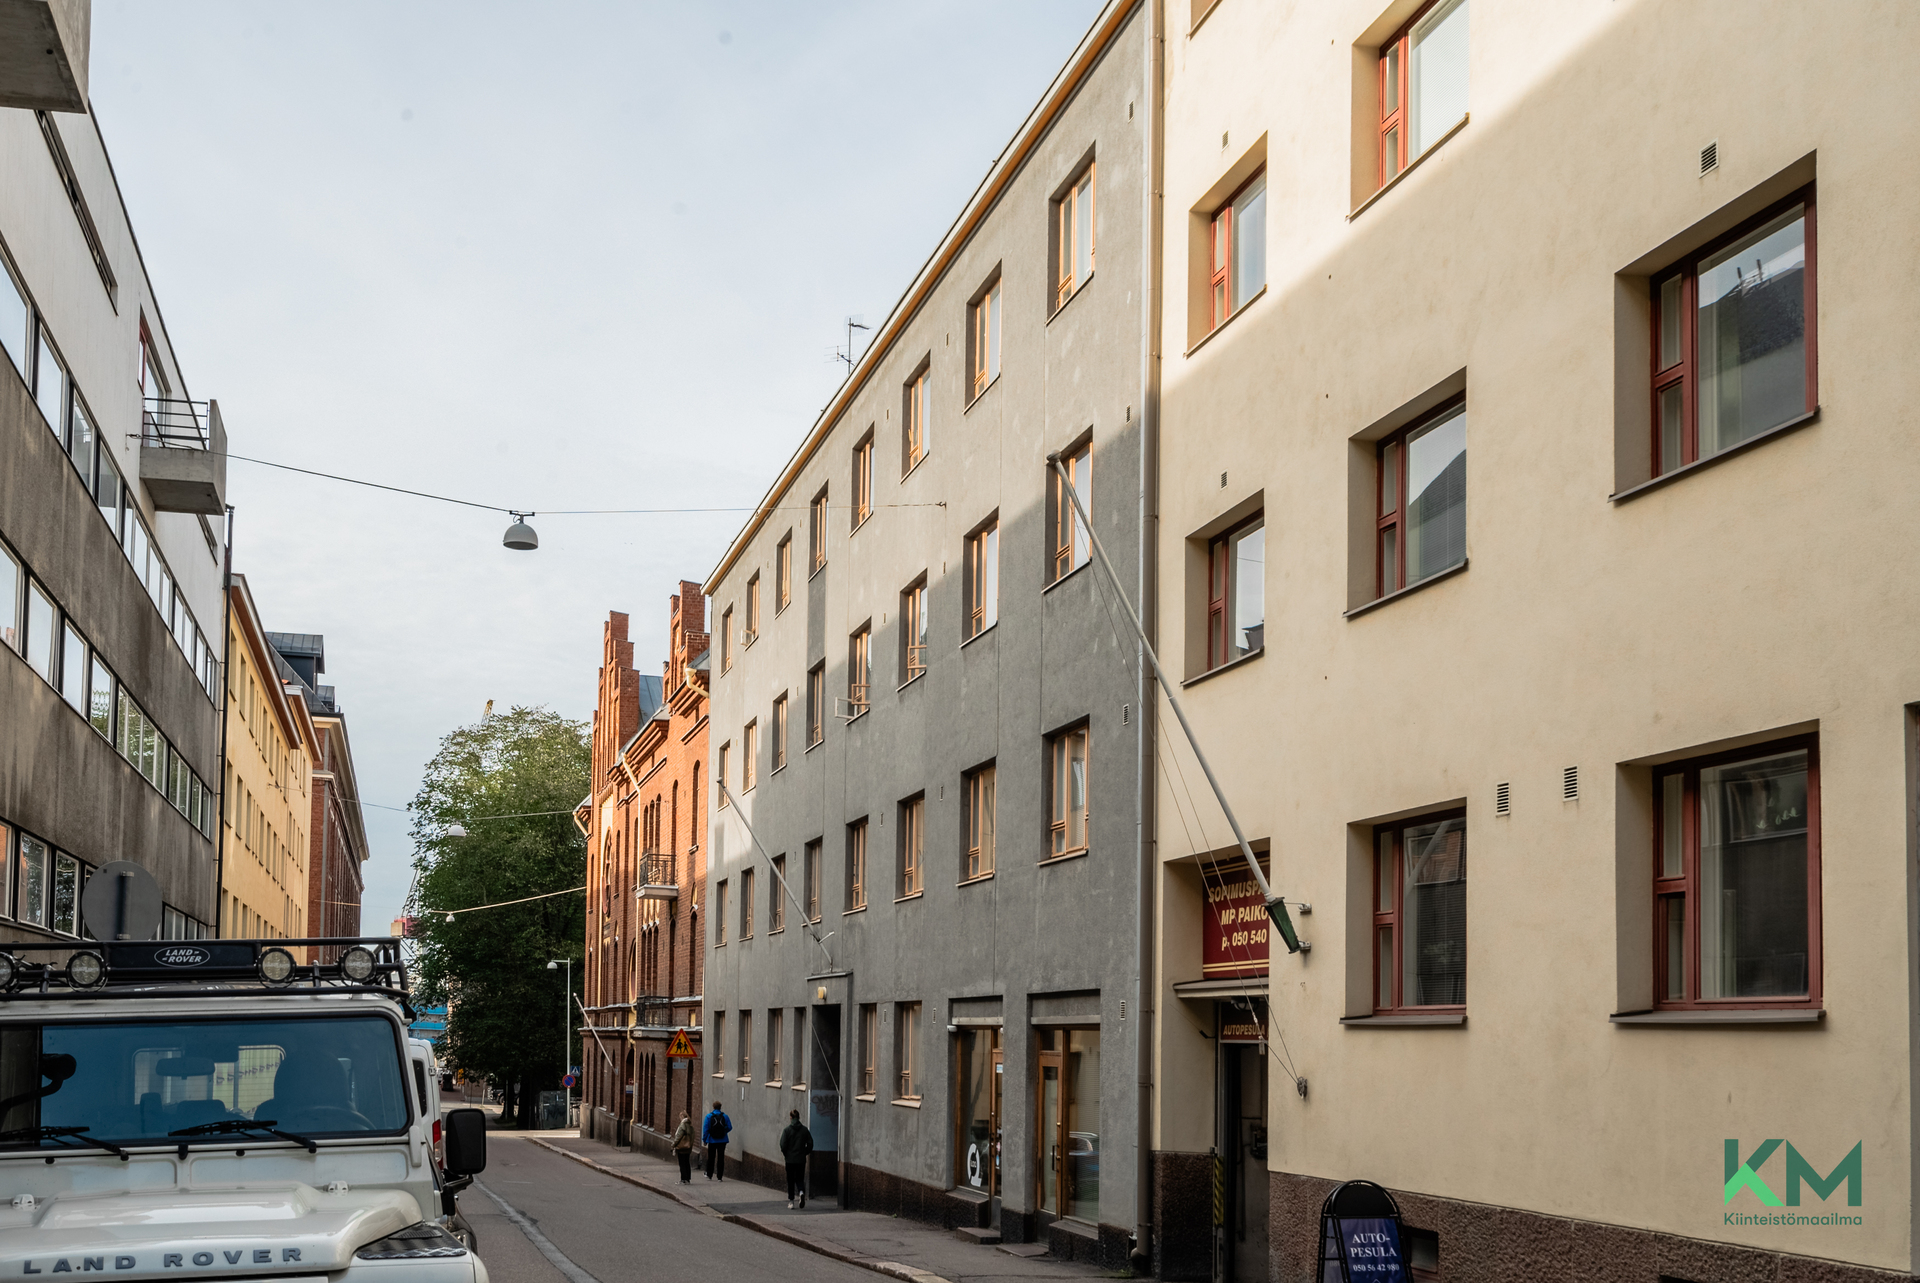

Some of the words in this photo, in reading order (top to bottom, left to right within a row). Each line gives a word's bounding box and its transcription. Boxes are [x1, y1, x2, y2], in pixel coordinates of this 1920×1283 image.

[1221, 909, 1236, 926] MP
[1232, 931, 1248, 947] 050
[1250, 928, 1267, 944] 540
[1352, 1233, 1391, 1244] AUTO-
[1350, 1246, 1397, 1258] PESULA
[23, 1255, 137, 1275] LAND
[163, 1247, 303, 1268] ROVER
[1352, 1264, 1367, 1272] 050
[1367, 1264, 1376, 1272] 56
[1386, 1263, 1400, 1271] 980
